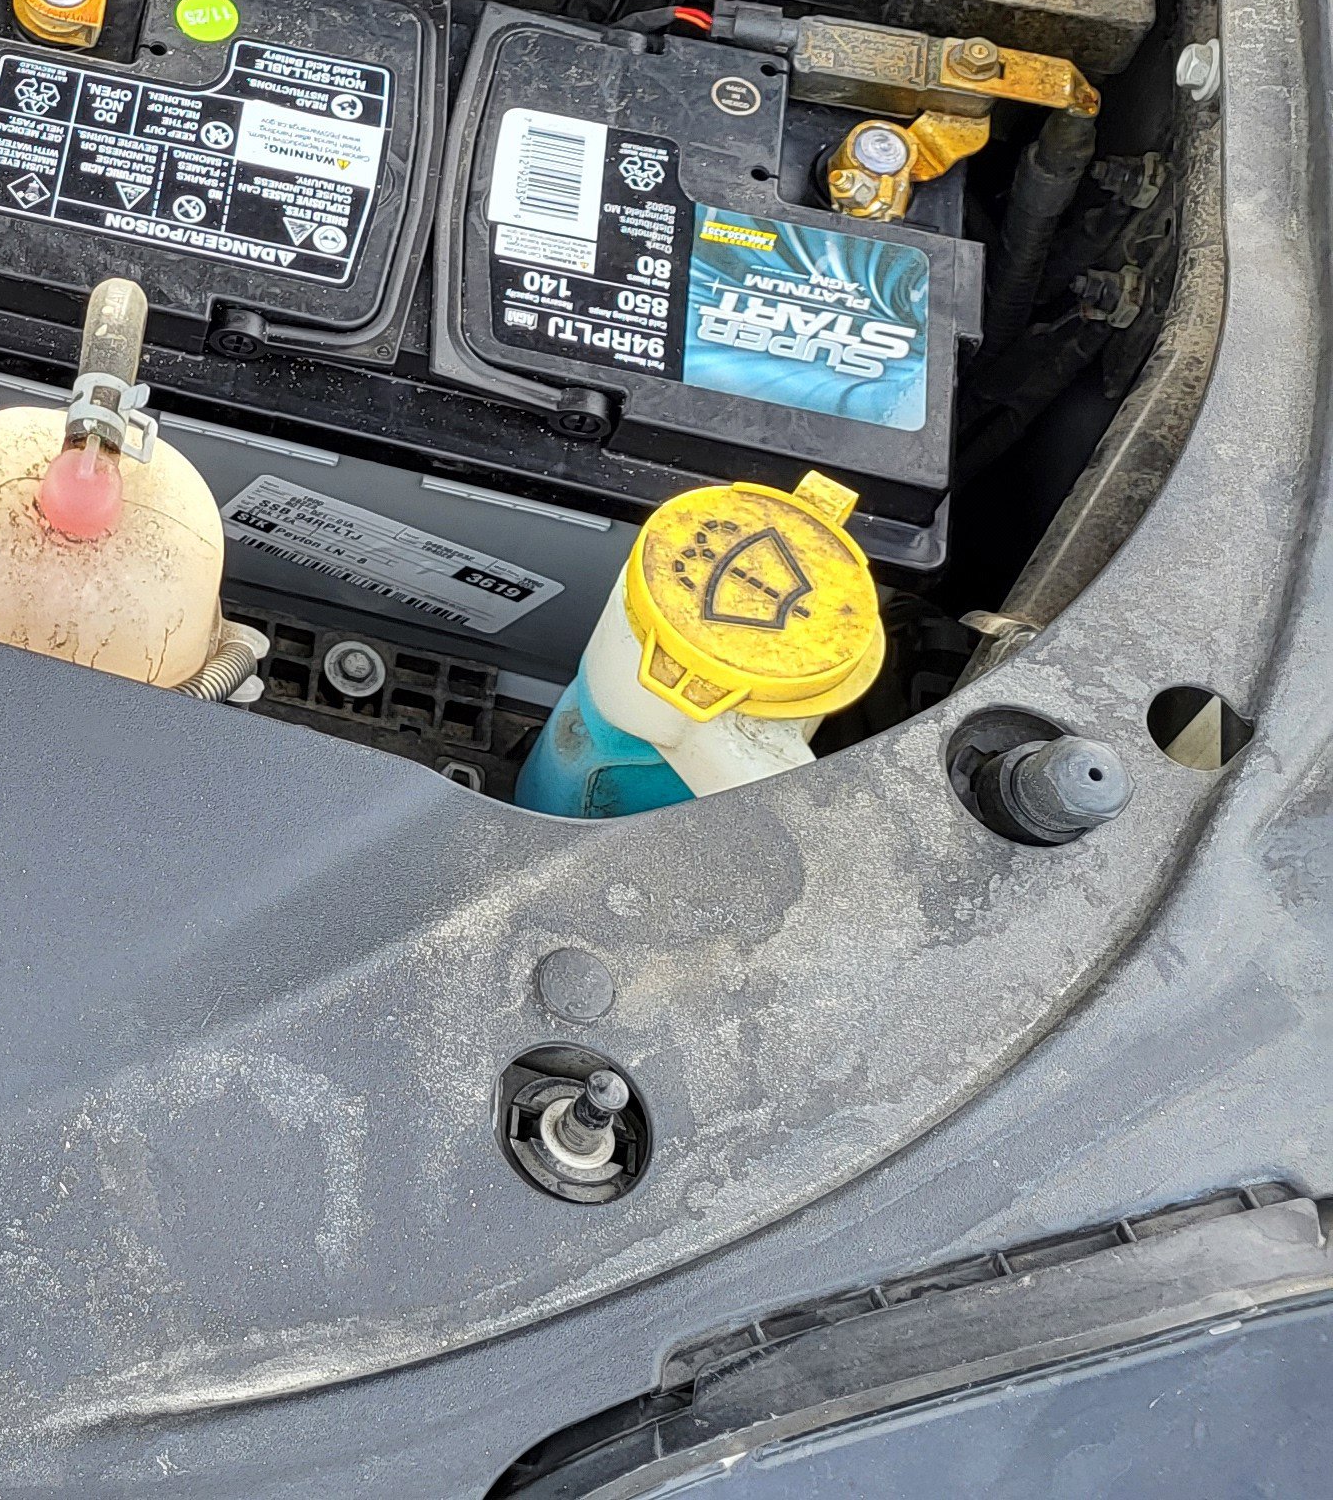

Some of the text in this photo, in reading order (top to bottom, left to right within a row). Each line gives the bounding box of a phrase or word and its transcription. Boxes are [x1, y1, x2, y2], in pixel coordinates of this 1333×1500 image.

[182, 2, 233, 27] 11/25
[262, 49, 361, 78] Lead Acid Battery
[253, 57, 366, 91] NON-SPILLABLE
[87, 82, 133, 101] OPEN.
[91, 95, 124, 112] NOT
[147, 100, 200, 119] REACH OF
[295, 96, 327, 111] READ
[93, 108, 118, 124] DO
[161, 115, 198, 130] OF THE
[37, 119, 65, 134] HELP
[38, 128, 62, 141] GET
[143, 122, 196, 141] KEEP OUT
[31, 142, 60, 156] WITH
[80, 140, 157, 163] BLINDNESS OR
[118, 136, 160, 153] SEVERE
[263, 141, 336, 167] WARNING:
[95, 153, 155, 173] CAN CAUSE
[172, 148, 222, 166] SMOKING
[22, 159, 55, 175] FLUSH
[79, 160, 153, 185] SULFURIC ACID
[177, 160, 220, 177] FLAMES
[175, 171, 218, 187] SPARKS
[337, 182, 353, 194] OR
[237, 182, 350, 214] EXPLOSIVE GASES CAN
[253, 175, 352, 204] CAUSE BLINDNESS
[619, 214, 674, 233] Distributors
[104, 212, 276, 263] DANGER/POISON
[620, 225, 674, 243] Automotive
[635, 254, 673, 278] 80
[522, 270, 573, 297] 140
[742, 272, 871, 311] PLATINUM
[616, 289, 670, 316] 850
[507, 308, 667, 358] 94RPLTJ AGM
[693, 290, 917, 357] START
[695, 315, 887, 378] SUPER
[235, 511, 270, 529] STK
[292, 510, 364, 542] 94RPLTJ
[463, 570, 524, 599] 3619
